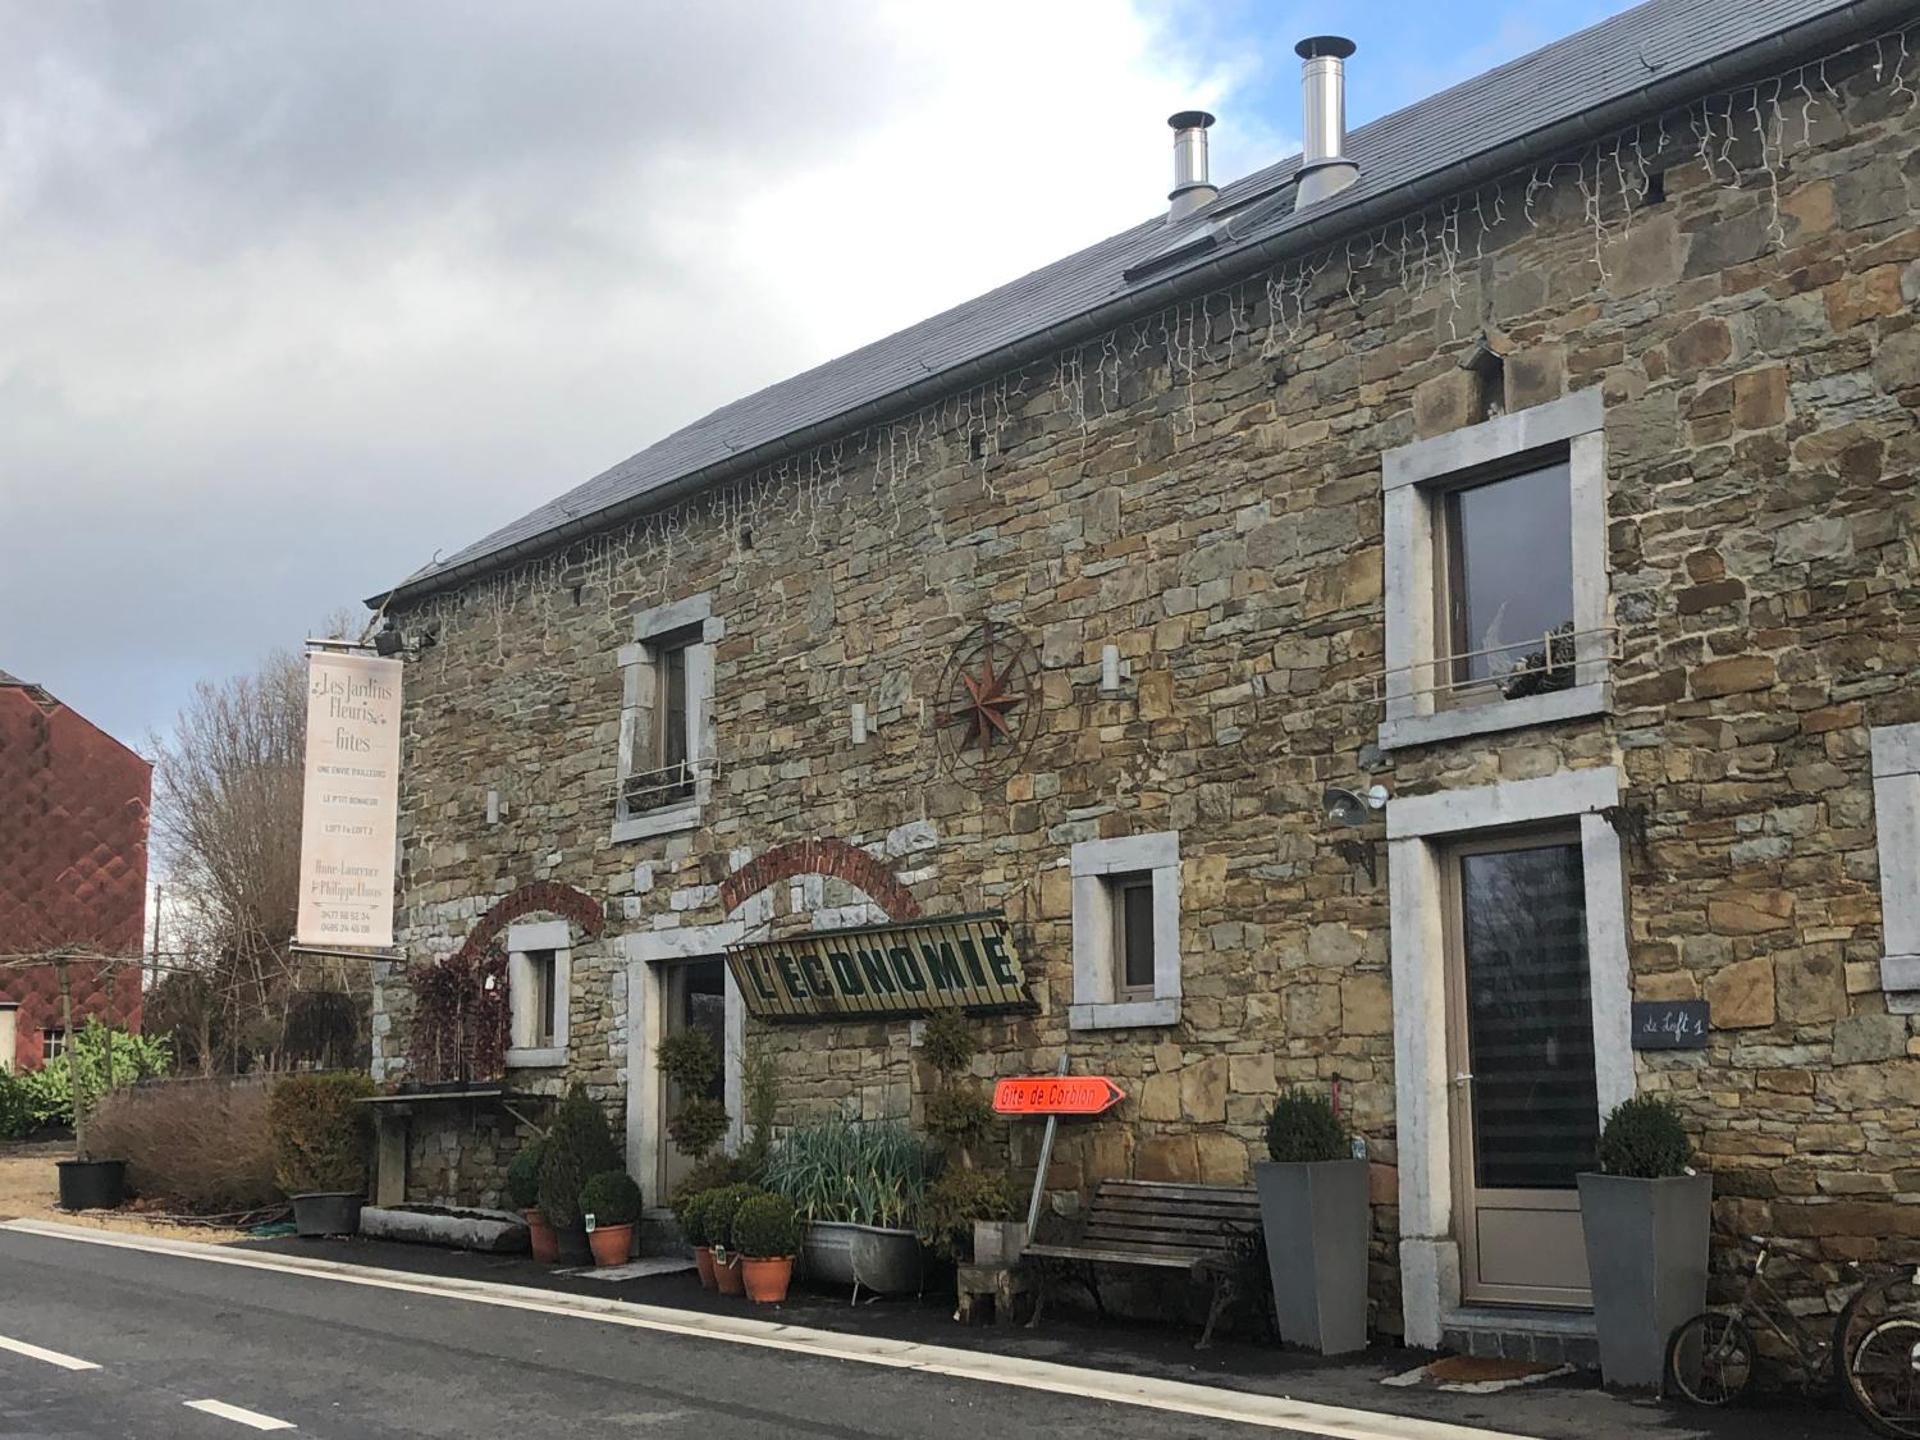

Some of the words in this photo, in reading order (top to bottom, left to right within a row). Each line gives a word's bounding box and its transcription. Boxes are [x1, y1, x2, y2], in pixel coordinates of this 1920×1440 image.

[320, 672, 344, 696] Les
[346, 675, 392, 703] Jardins
[330, 696, 374, 724] Fleuris
[1694, 1018, 1704, 1036] 1
[1030, 1086, 1044, 1106] de
[1049, 1084, 1096, 1106] Corbion
